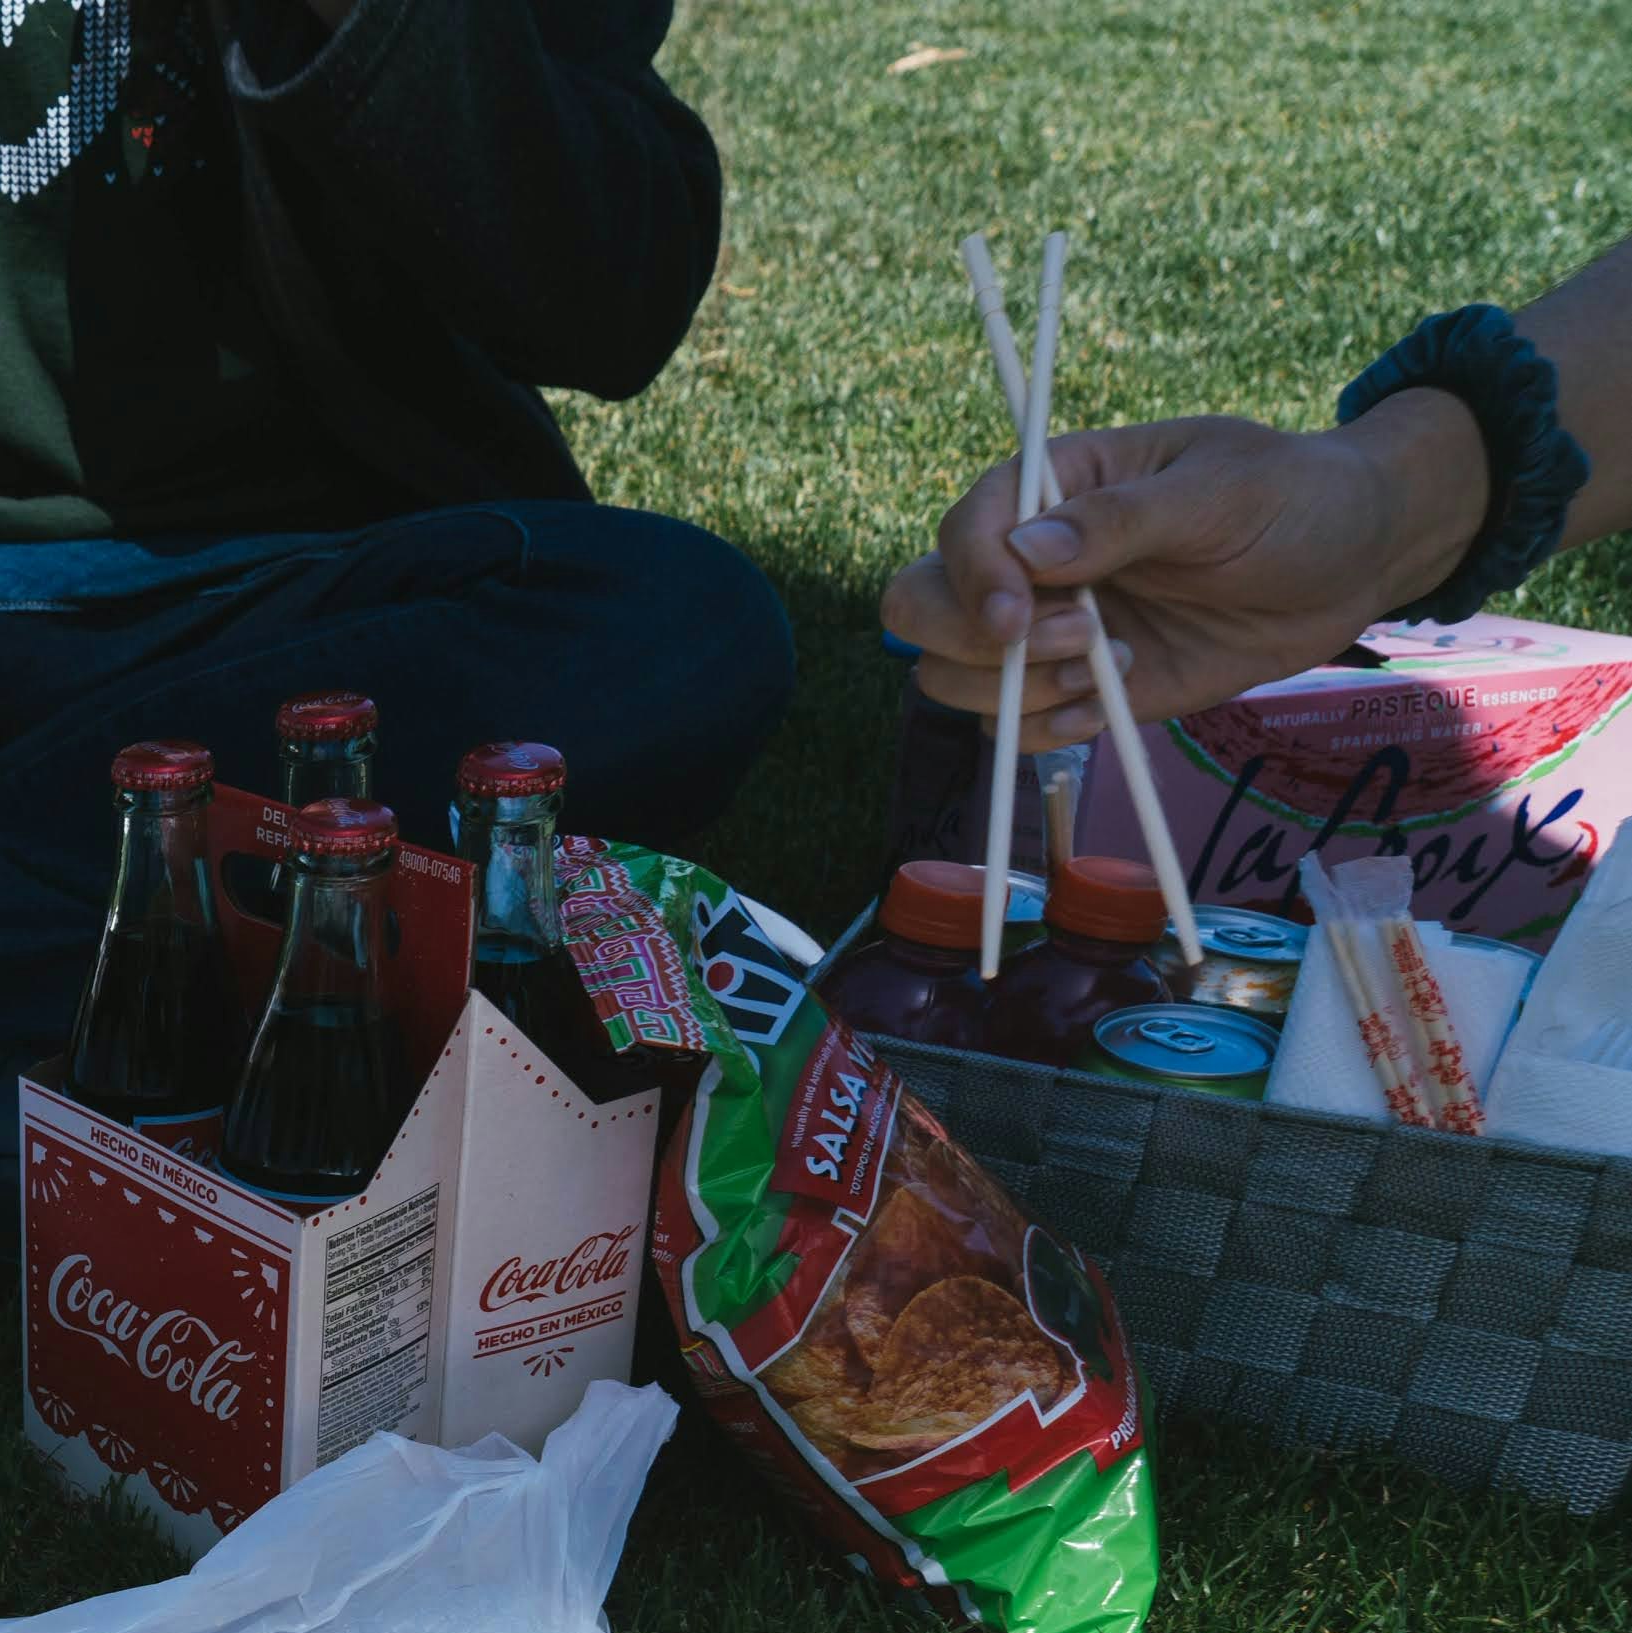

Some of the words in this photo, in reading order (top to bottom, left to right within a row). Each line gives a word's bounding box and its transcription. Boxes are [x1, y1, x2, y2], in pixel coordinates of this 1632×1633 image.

[1262, 709, 1346, 730] NATURALLY
[1482, 687, 1558, 707] ESSENCED
[1331, 729, 1423, 749] SPARKLING
[1430, 722, 1482, 739] WATER
[399, 850, 461, 885] 49000-07546
[791, 1105, 812, 1148] Naturally
[804, 1085, 816, 1105] and
[806, 1072, 868, 1180] SALSA
[90, 1127, 139, 1163] HECHO
[141, 1156, 161, 1176] EN
[163, 1167, 219, 1205] MÉXICO
[850, 1151, 871, 1196] TOTOPOS
[863, 1139, 874, 1152] DE
[479, 1222, 641, 1312] Coca-Cola
[325, 1309, 343, 1324] Total
[381, 1281, 398, 1297] Total
[478, 1326, 535, 1350] HECHO
[539, 1319, 560, 1335] EN
[564, 1301, 623, 1328] MÉXICO
[48, 1254, 256, 1421] Coca-Cola
[368, 1323, 384, 1338] Total
